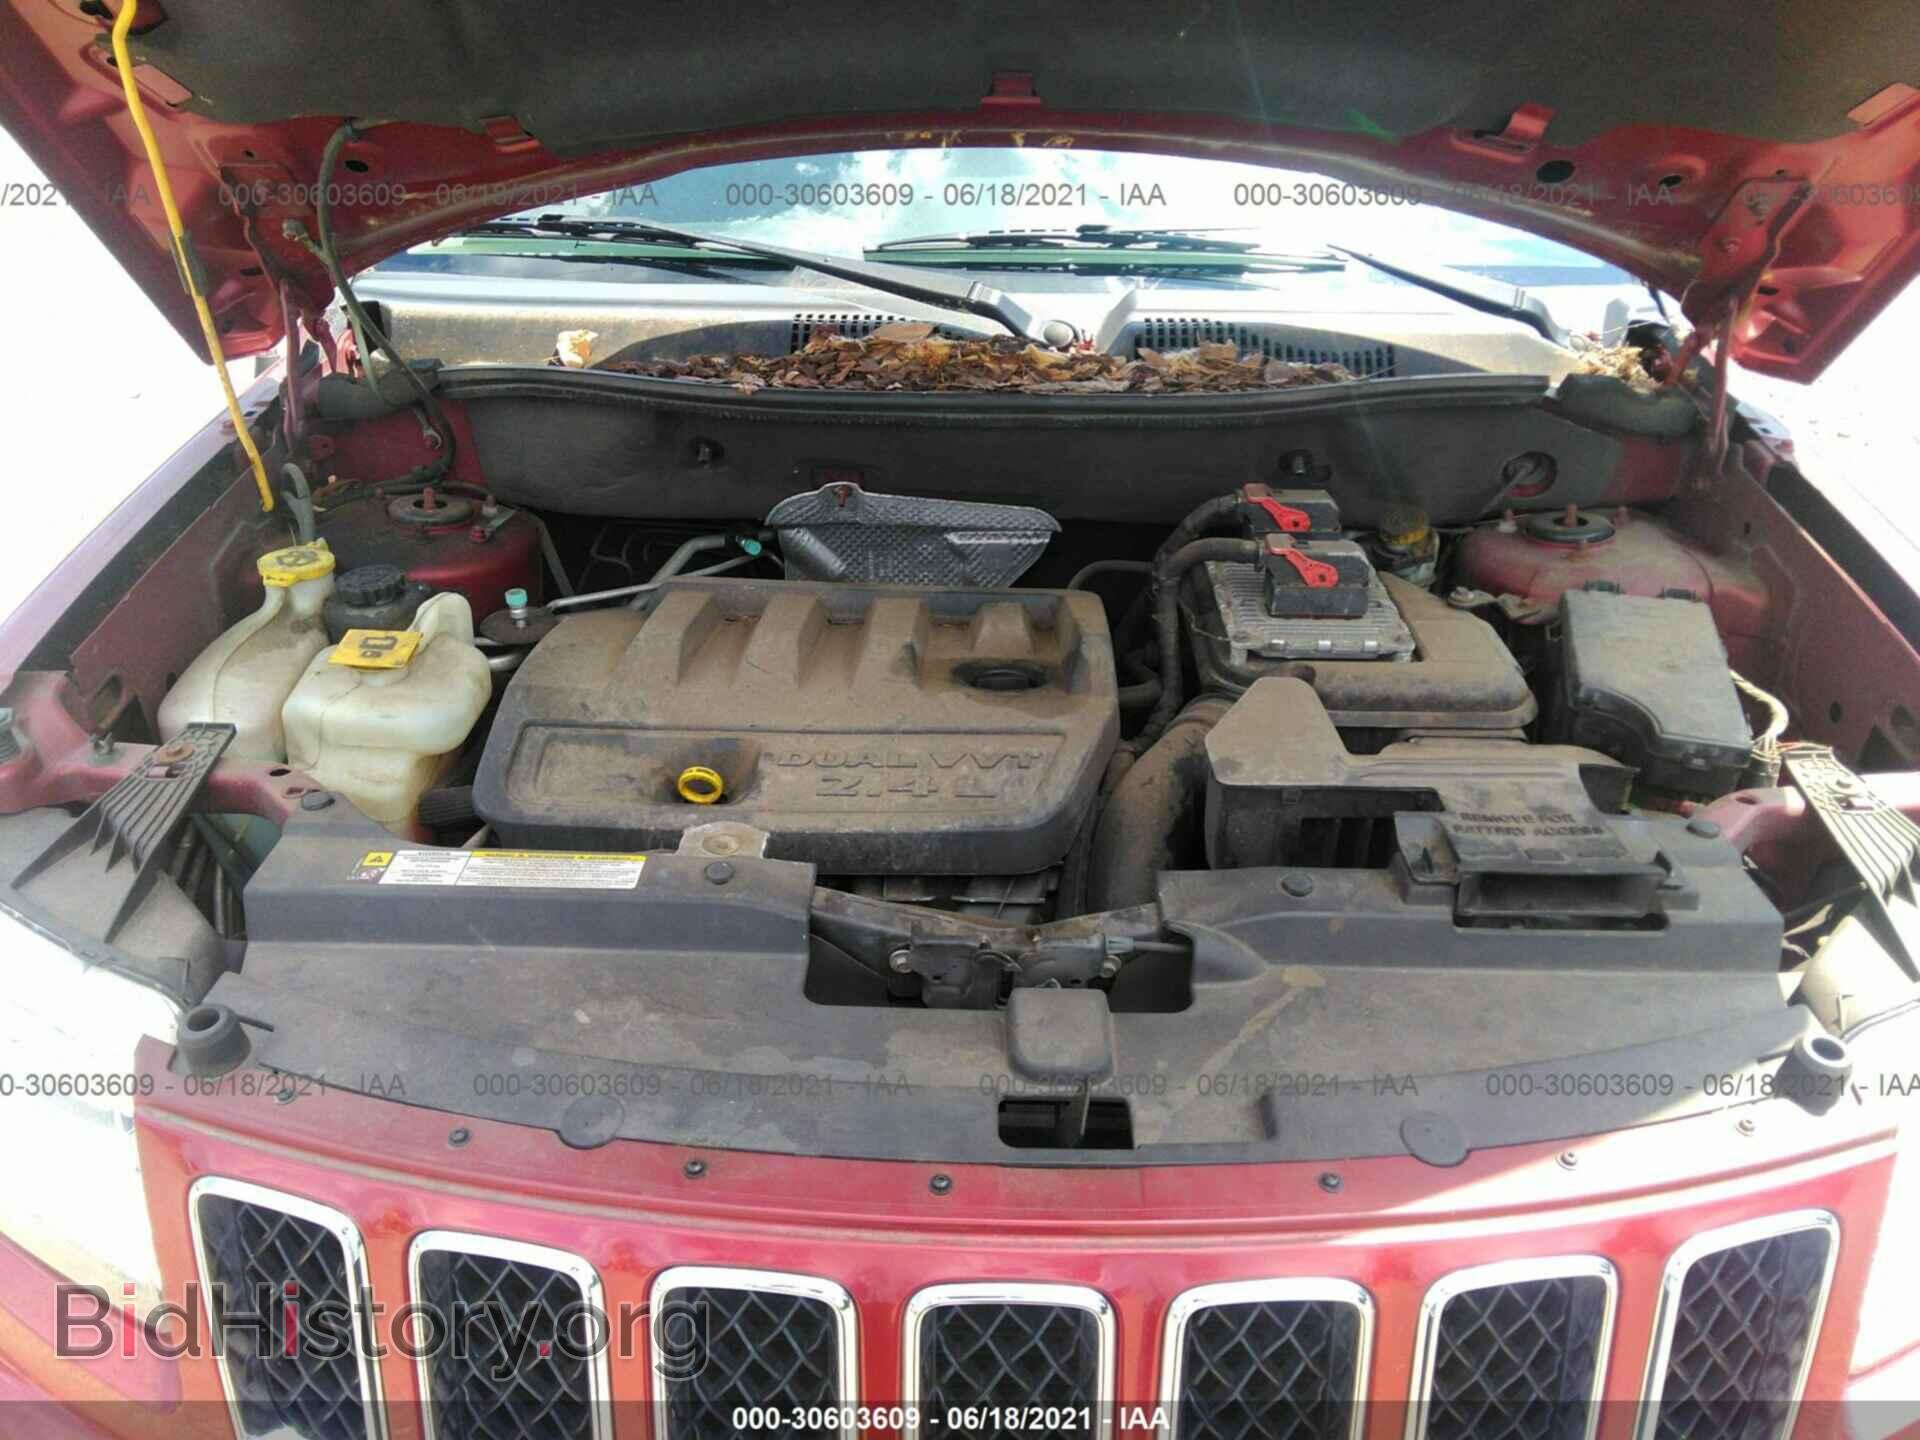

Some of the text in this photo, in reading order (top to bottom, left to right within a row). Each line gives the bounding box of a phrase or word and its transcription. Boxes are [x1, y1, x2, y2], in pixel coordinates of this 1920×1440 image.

[777, 752, 1043, 770] DUAL VVT
[1459, 812, 1576, 824] REMOVE FOR
[1453, 824, 1604, 837] BATTERY ACCESS
